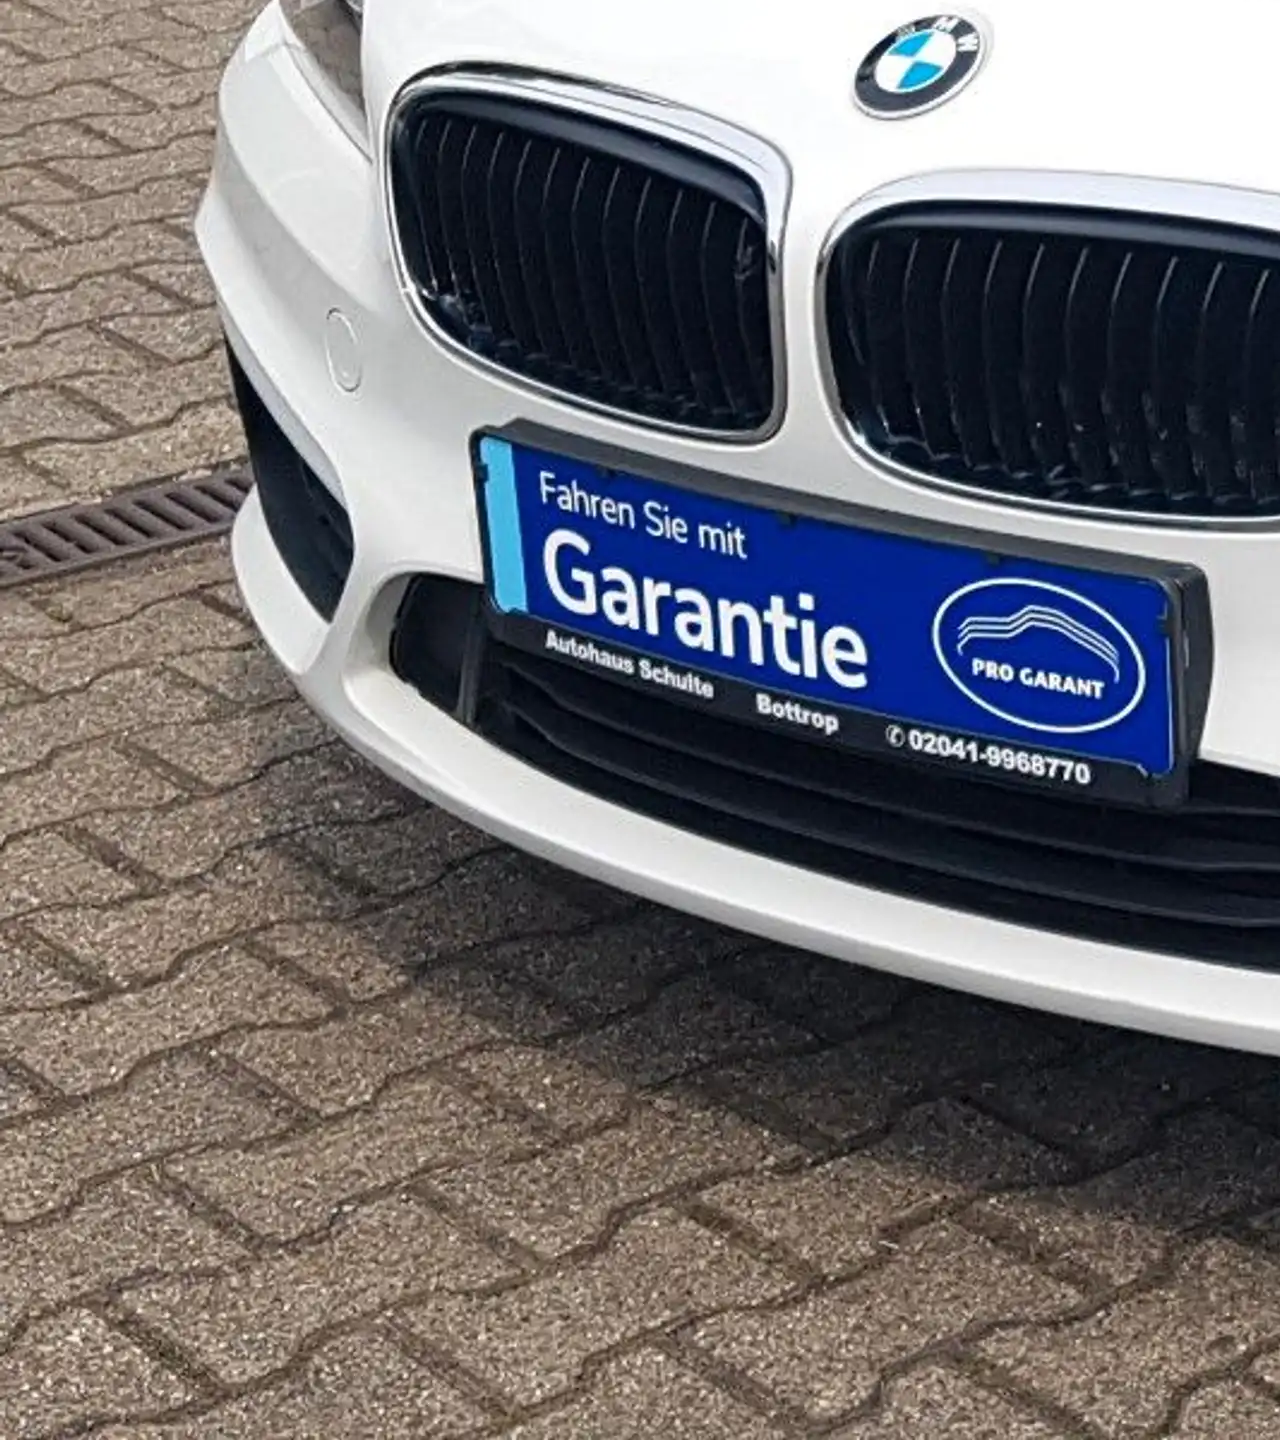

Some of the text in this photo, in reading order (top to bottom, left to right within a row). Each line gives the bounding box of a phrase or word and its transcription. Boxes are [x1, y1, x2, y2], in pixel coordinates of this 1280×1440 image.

[539, 471, 748, 559] Fahren Sie mit
[543, 528, 868, 688] Garantie
[545, 629, 714, 698] Autohaus Schulte
[971, 658, 1105, 699] PRO GARANT
[755, 692, 839, 736] Bottrop
[908, 729, 1091, 784] 02041-9968770
